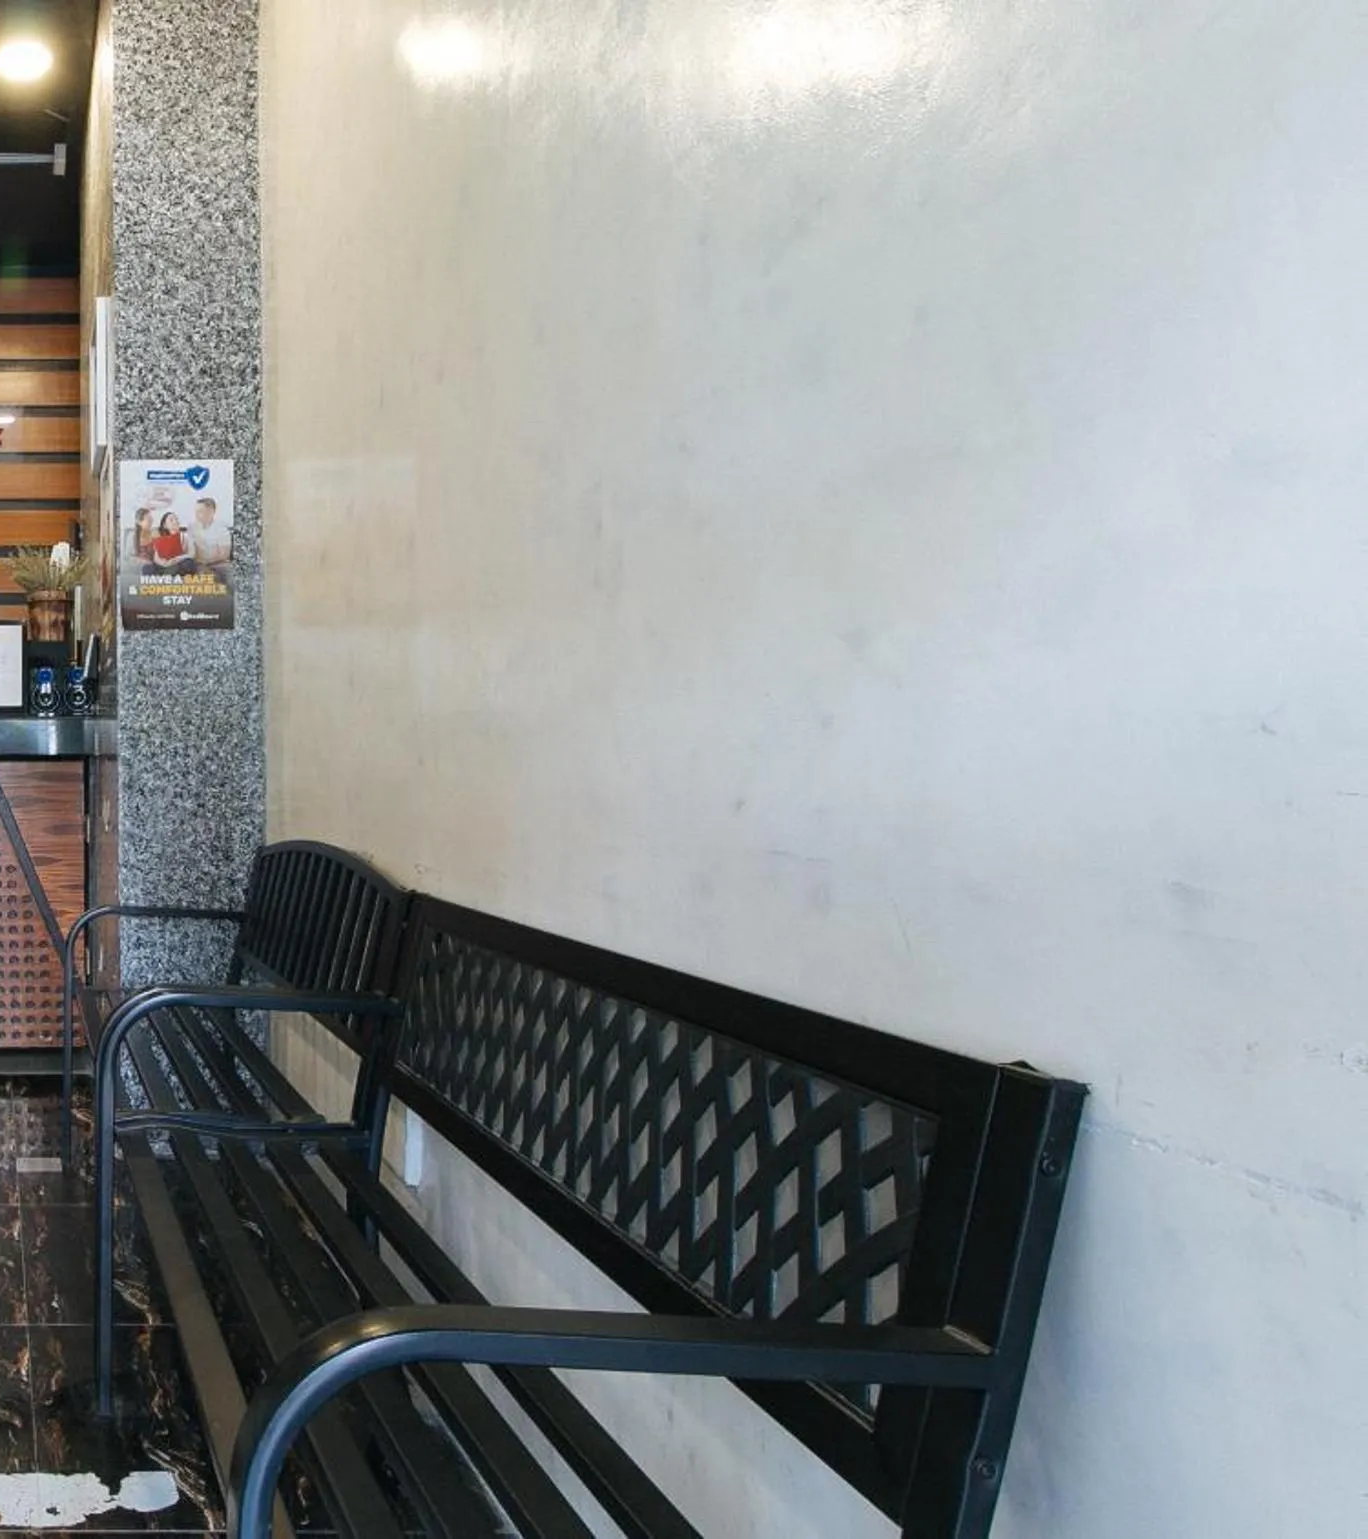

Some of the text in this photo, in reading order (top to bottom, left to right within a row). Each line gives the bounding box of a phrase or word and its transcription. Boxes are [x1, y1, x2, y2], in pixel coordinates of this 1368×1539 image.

[140, 574, 172, 584] HAVE
[184, 573, 214, 584] SAFE
[163, 595, 192, 605] STAY
